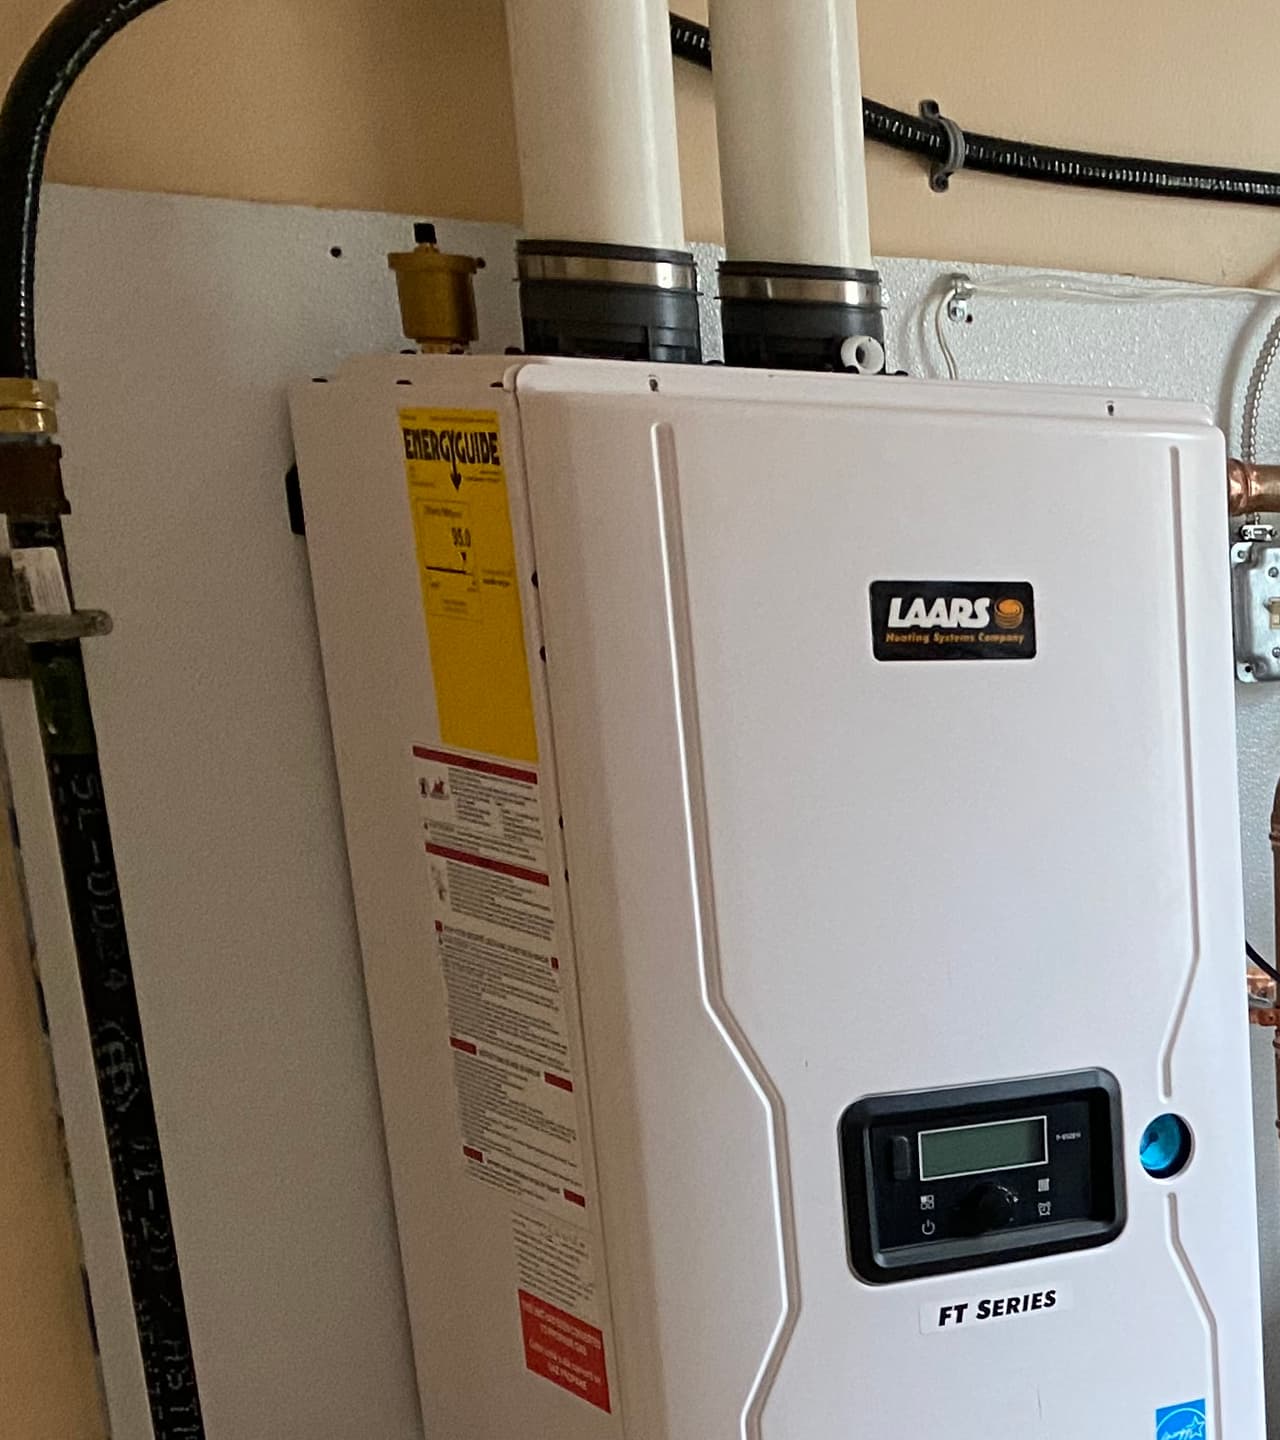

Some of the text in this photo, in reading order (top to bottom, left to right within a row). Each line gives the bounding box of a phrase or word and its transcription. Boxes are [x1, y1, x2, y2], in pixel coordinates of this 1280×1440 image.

[402, 427, 501, 466] ENERGYGUIDE
[887, 597, 992, 629] LAARS
[885, 632, 1025, 645] Heating Systems Company
[938, 1289, 1057, 1327] FT SERIES
